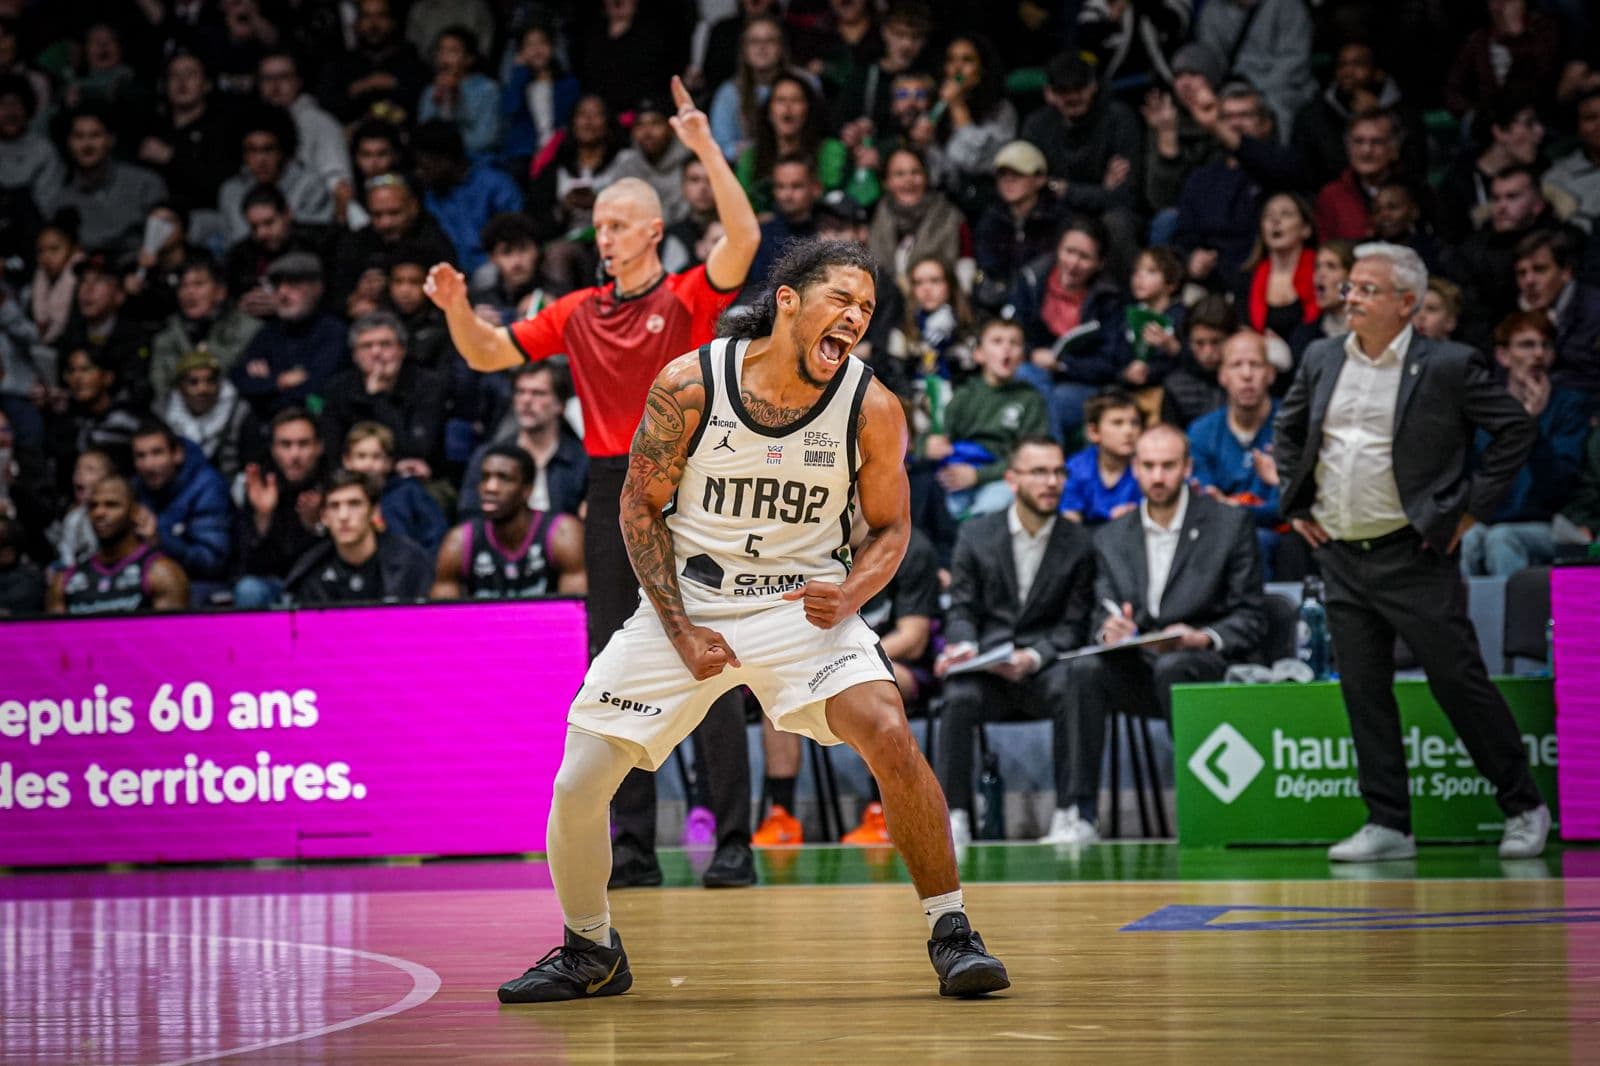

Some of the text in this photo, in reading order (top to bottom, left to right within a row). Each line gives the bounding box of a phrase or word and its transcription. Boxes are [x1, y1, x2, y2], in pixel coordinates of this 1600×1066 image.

[803, 438, 841, 449] SPORT
[804, 450, 836, 464] QUARTUS
[702, 475, 830, 525] NTR92
[745, 533, 764, 559] 5
[734, 573, 805, 586] GTM
[149, 682, 213, 732] 60
[228, 689, 319, 730] ans
[599, 691, 652, 716] Sepur
[85, 750, 367, 807] territoires.
